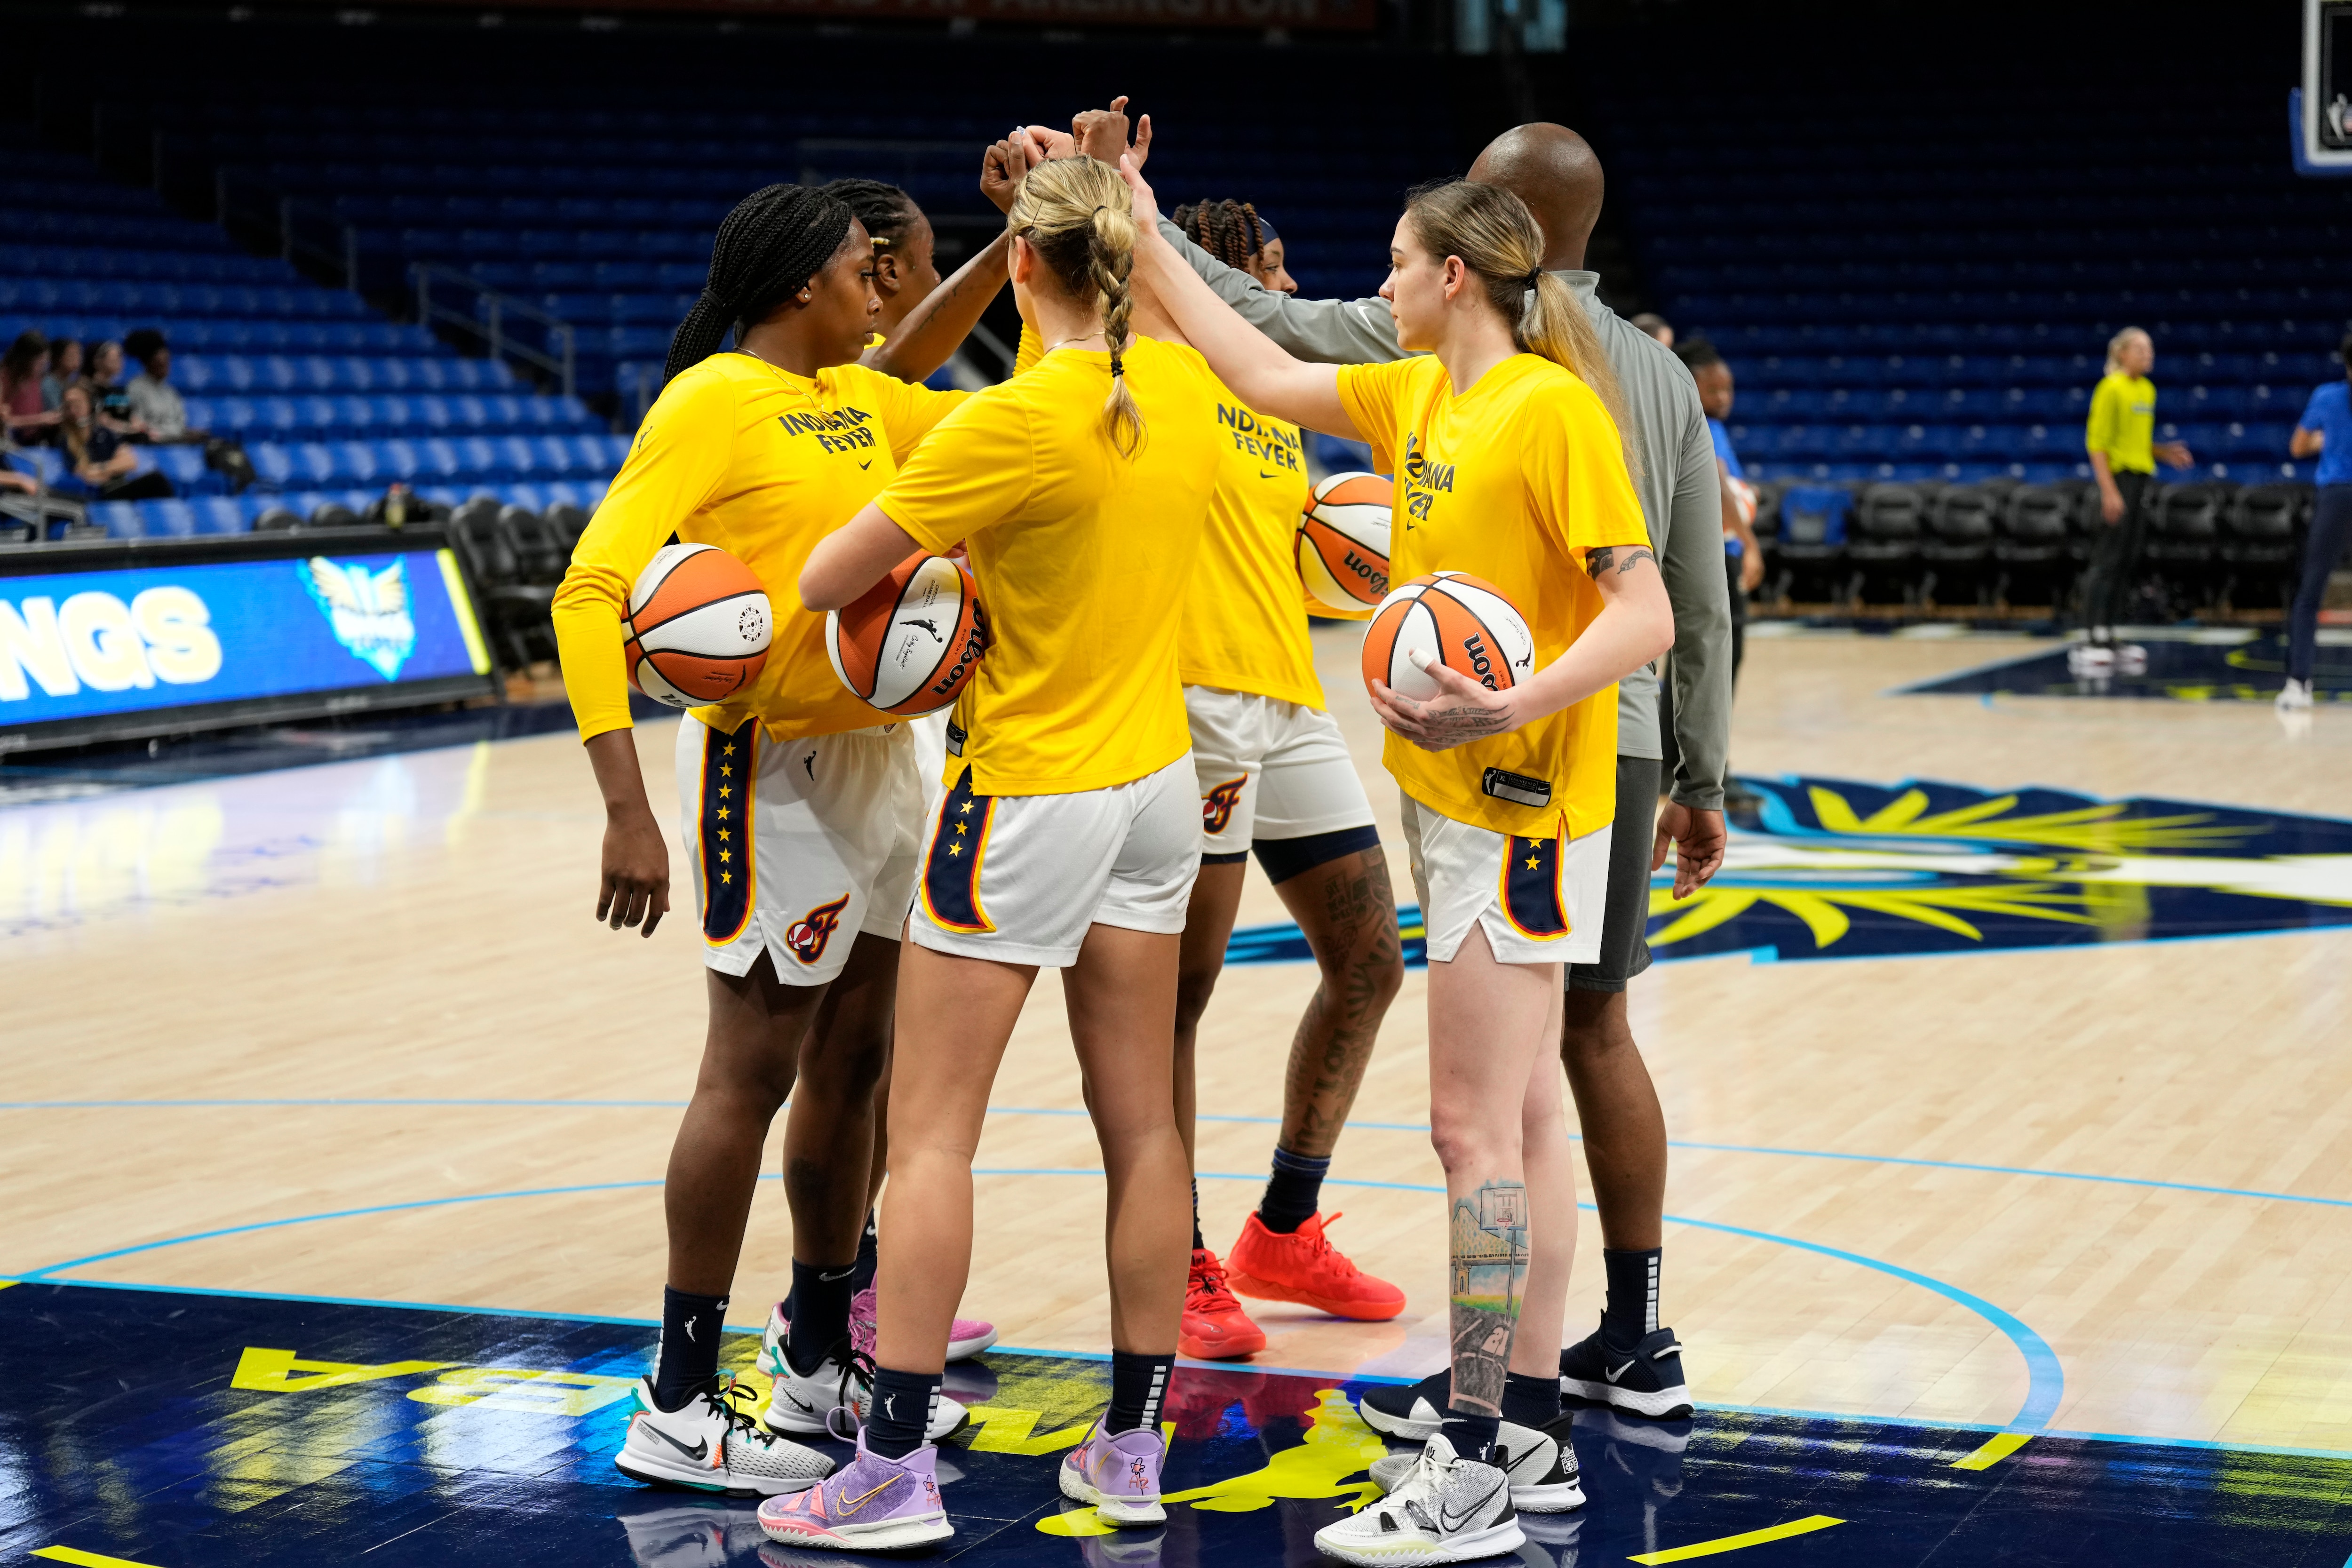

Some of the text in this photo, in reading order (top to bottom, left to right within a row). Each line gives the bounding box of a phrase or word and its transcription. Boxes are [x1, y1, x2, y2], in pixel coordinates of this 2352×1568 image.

[778, 407, 873, 437] INDIANA
[1217, 402, 1303, 454] NDINA
[815, 427, 876, 454] FEVER
[1232, 431, 1300, 472] FEVER
[1343, 548, 1389, 598] ilson
[922, 595, 930, 609] BALL
[928, 585, 939, 607] OFFICIAL
[1510, 777, 1536, 787] ENGINEERED
